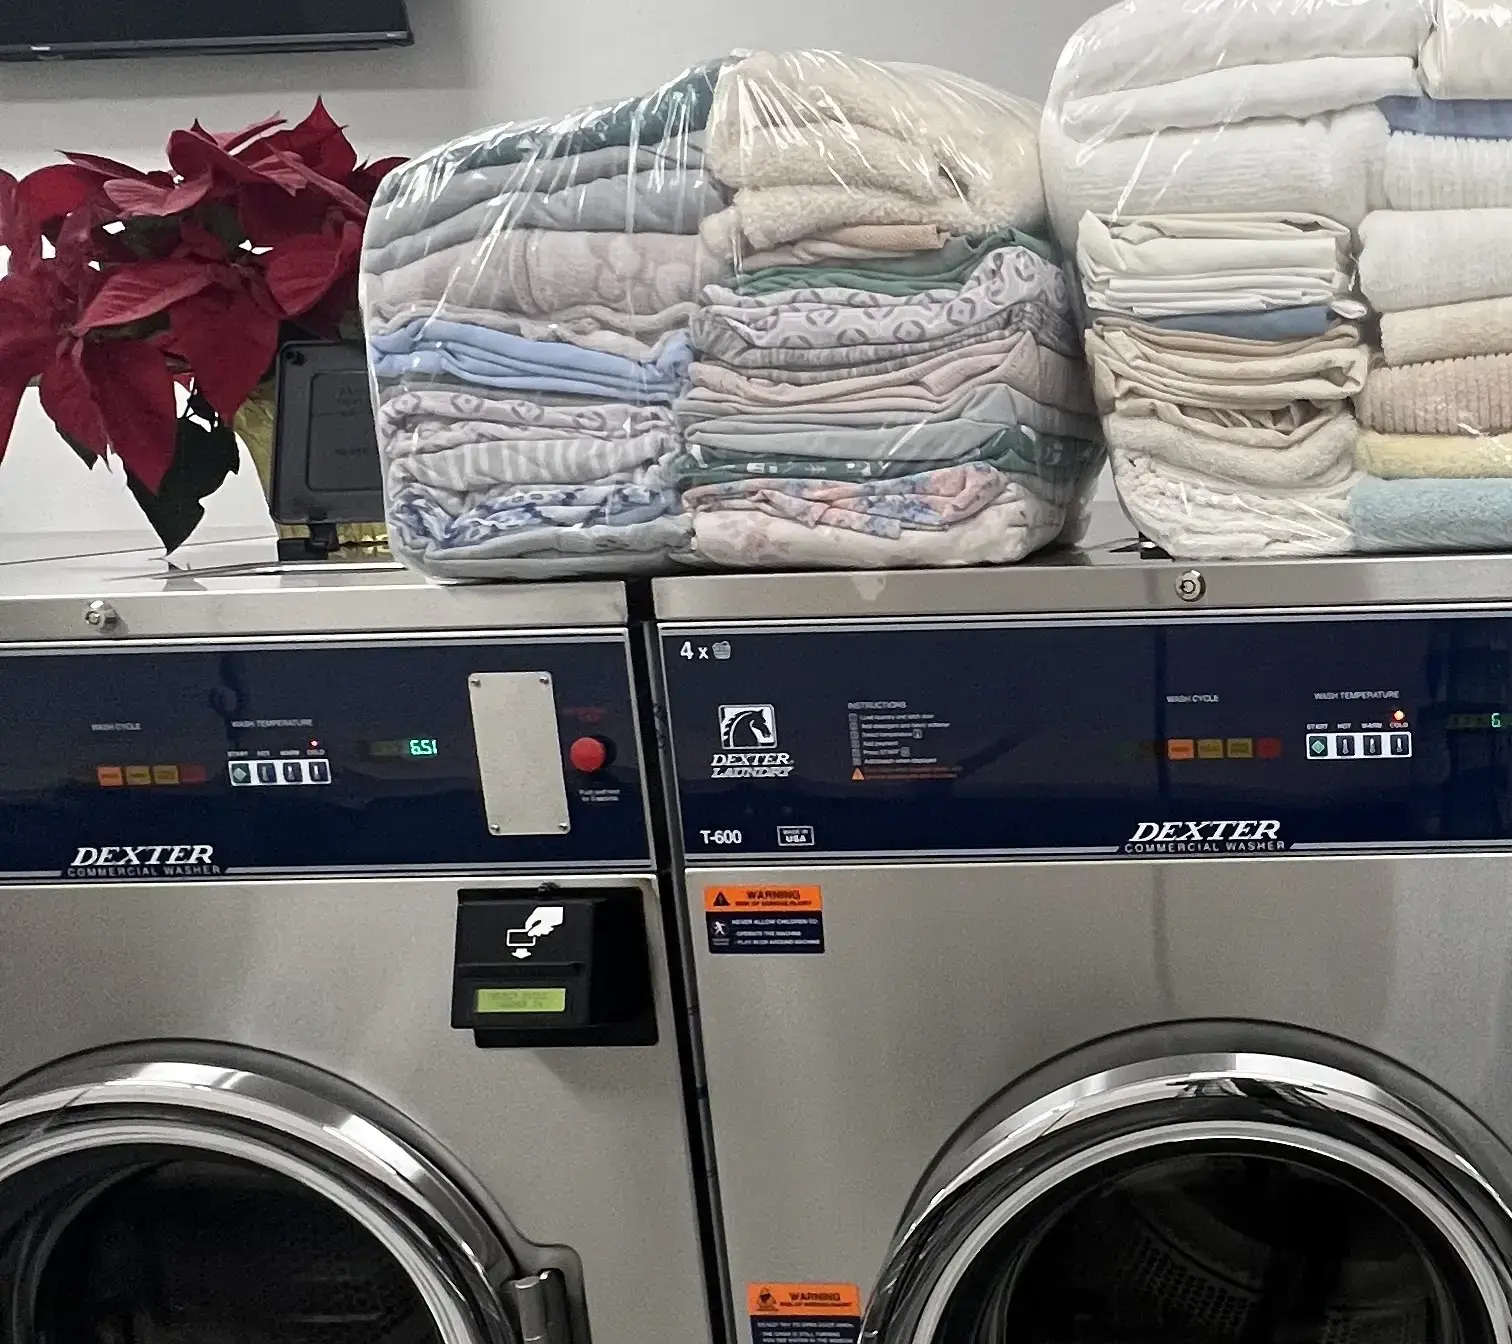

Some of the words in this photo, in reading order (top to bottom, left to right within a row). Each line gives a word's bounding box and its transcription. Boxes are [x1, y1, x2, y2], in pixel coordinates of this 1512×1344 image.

[680, 641, 694, 660] 4
[711, 753, 790, 766] DEXTER
[700, 830, 742, 844] T-600
[1129, 820, 1281, 842] DEXTER
[1124, 842, 1219, 853] COMMERCIAL
[1226, 840, 1285, 851] WASHER
[71, 845, 213, 867] DEXTER
[68, 865, 157, 876] COMMERCIAL
[163, 864, 221, 875] WASHER
